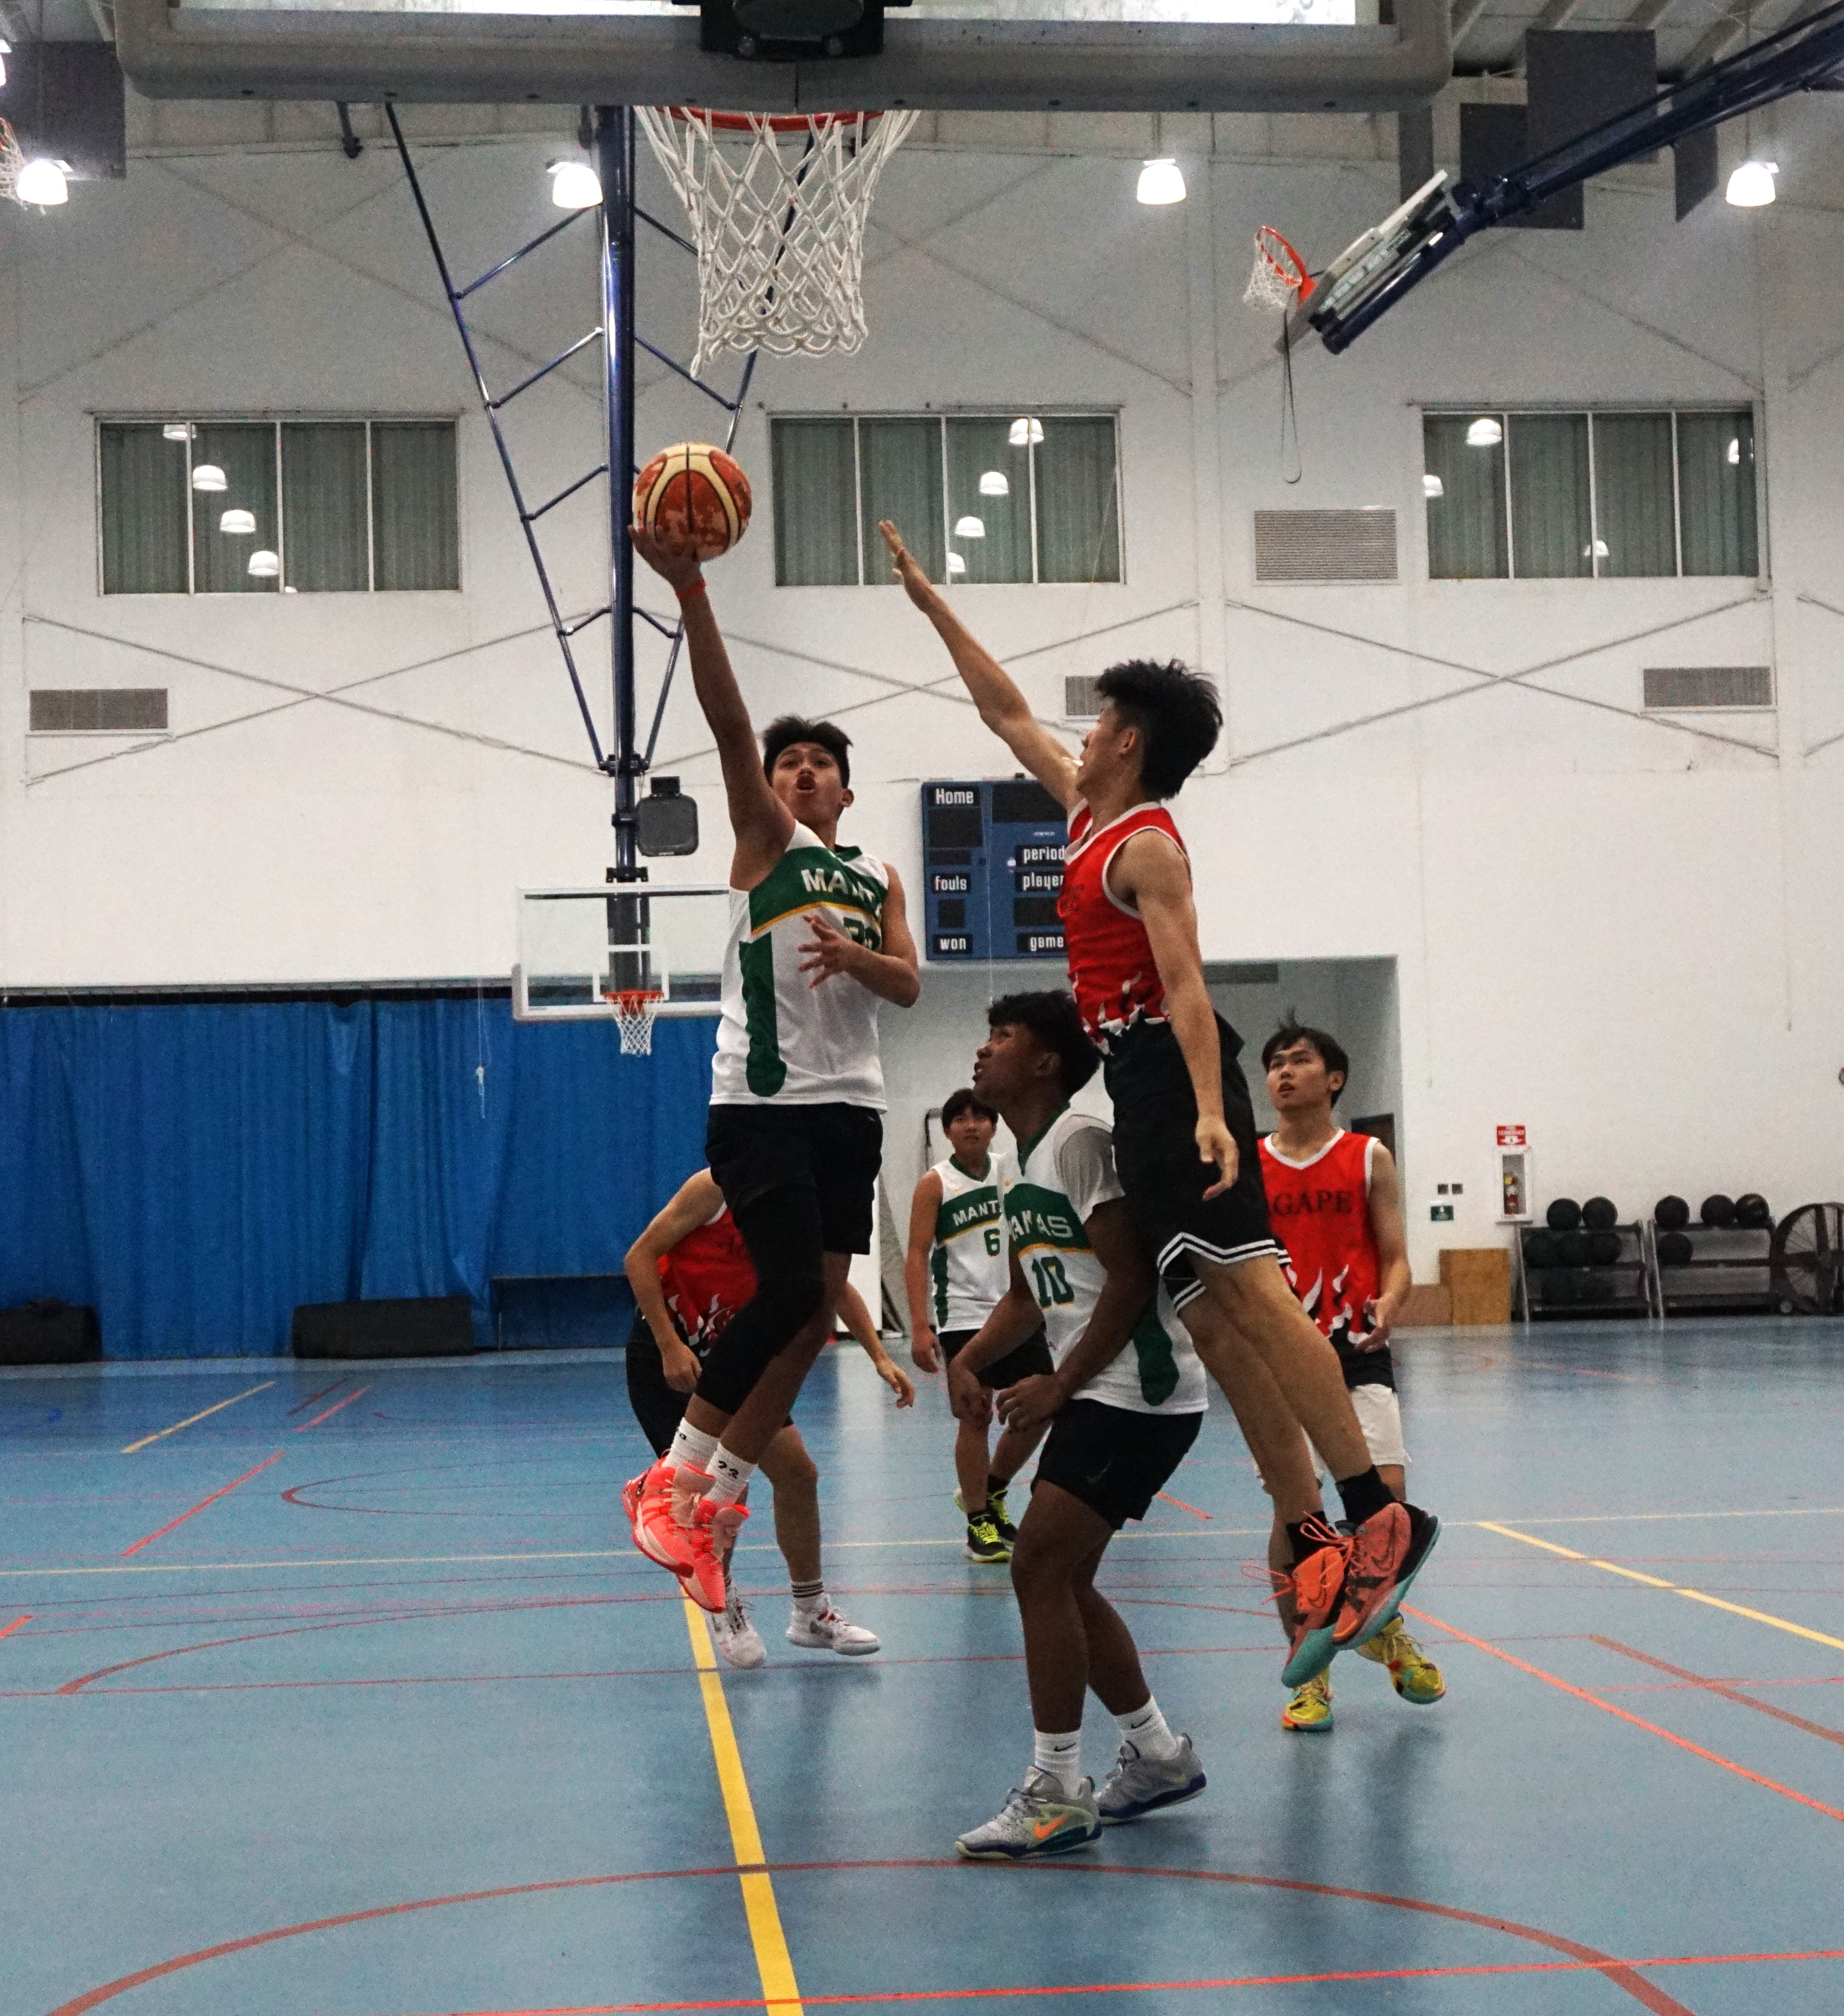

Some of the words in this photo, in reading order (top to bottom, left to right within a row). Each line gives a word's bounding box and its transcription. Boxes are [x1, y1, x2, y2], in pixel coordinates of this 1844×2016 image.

[935, 788, 974, 804] Home
[1023, 844, 1065, 864] period
[935, 875, 967, 891] fouls
[939, 937, 966, 950] won
[1030, 936, 1064, 952] game
[1268, 1189, 1352, 1216] GAPE
[952, 1200, 1004, 1227] MANT
[984, 1227, 1001, 1259] 6
[1032, 1255, 1075, 1310] 10
